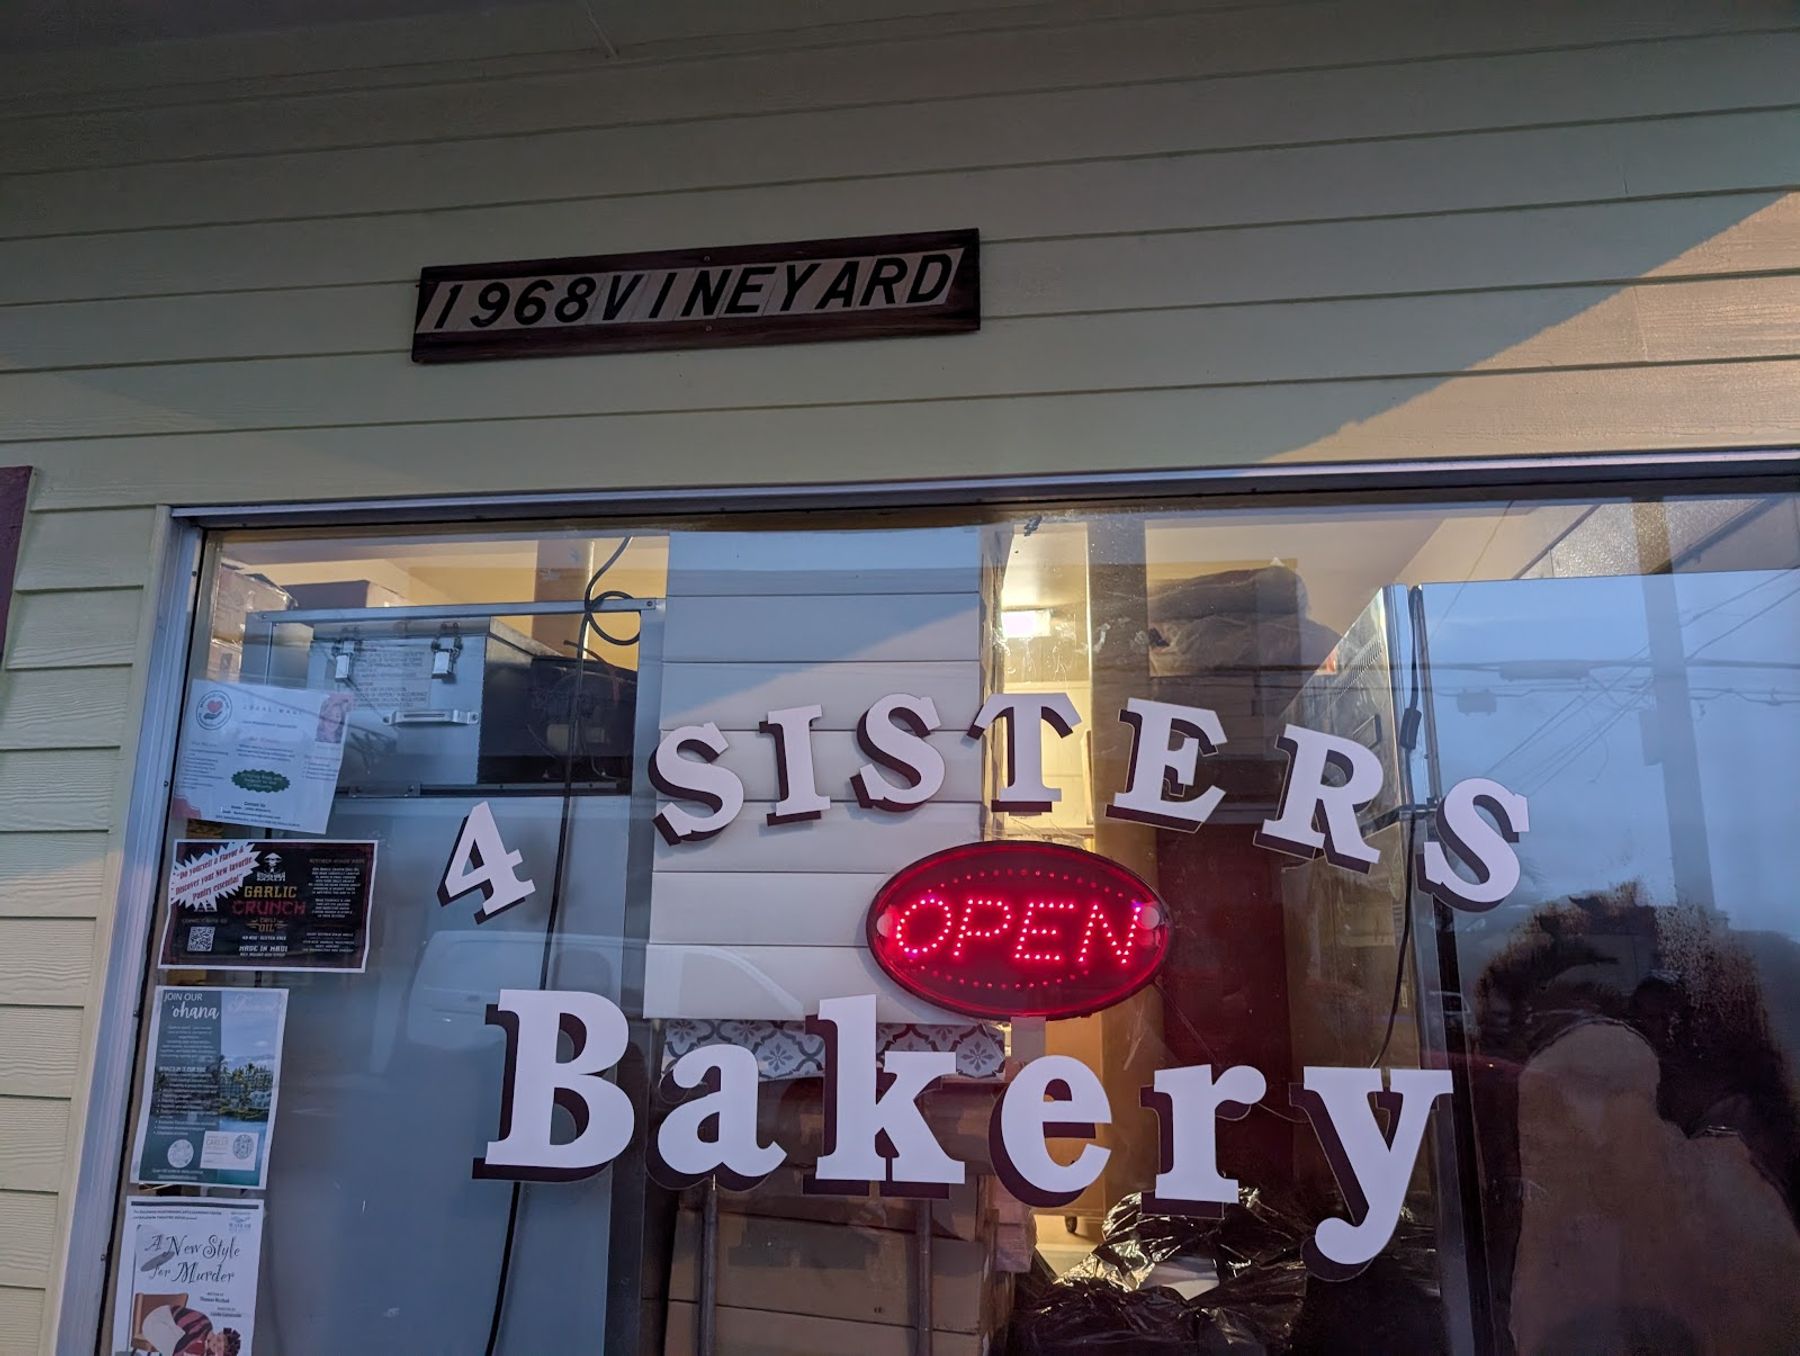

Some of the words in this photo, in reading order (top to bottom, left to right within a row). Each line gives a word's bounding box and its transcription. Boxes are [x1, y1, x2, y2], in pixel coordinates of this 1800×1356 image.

[602, 253, 952, 321] VINEYARD
[439, 801, 536, 922] 4
[650, 693, 1530, 910] SISTERS
[231, 900, 307, 915] CRUNCH
[244, 886, 298, 899] GARLIC
[896, 898, 1142, 965] OPEN
[163, 992, 182, 1002] JOIN
[184, 992, 203, 1002] OUR
[477, 989, 1454, 1272] Bakery
[145, 1233, 162, 1251] A
[166, 1234, 203, 1257] New
[202, 1234, 241, 1265] Style
[171, 1261, 235, 1284] Murder
